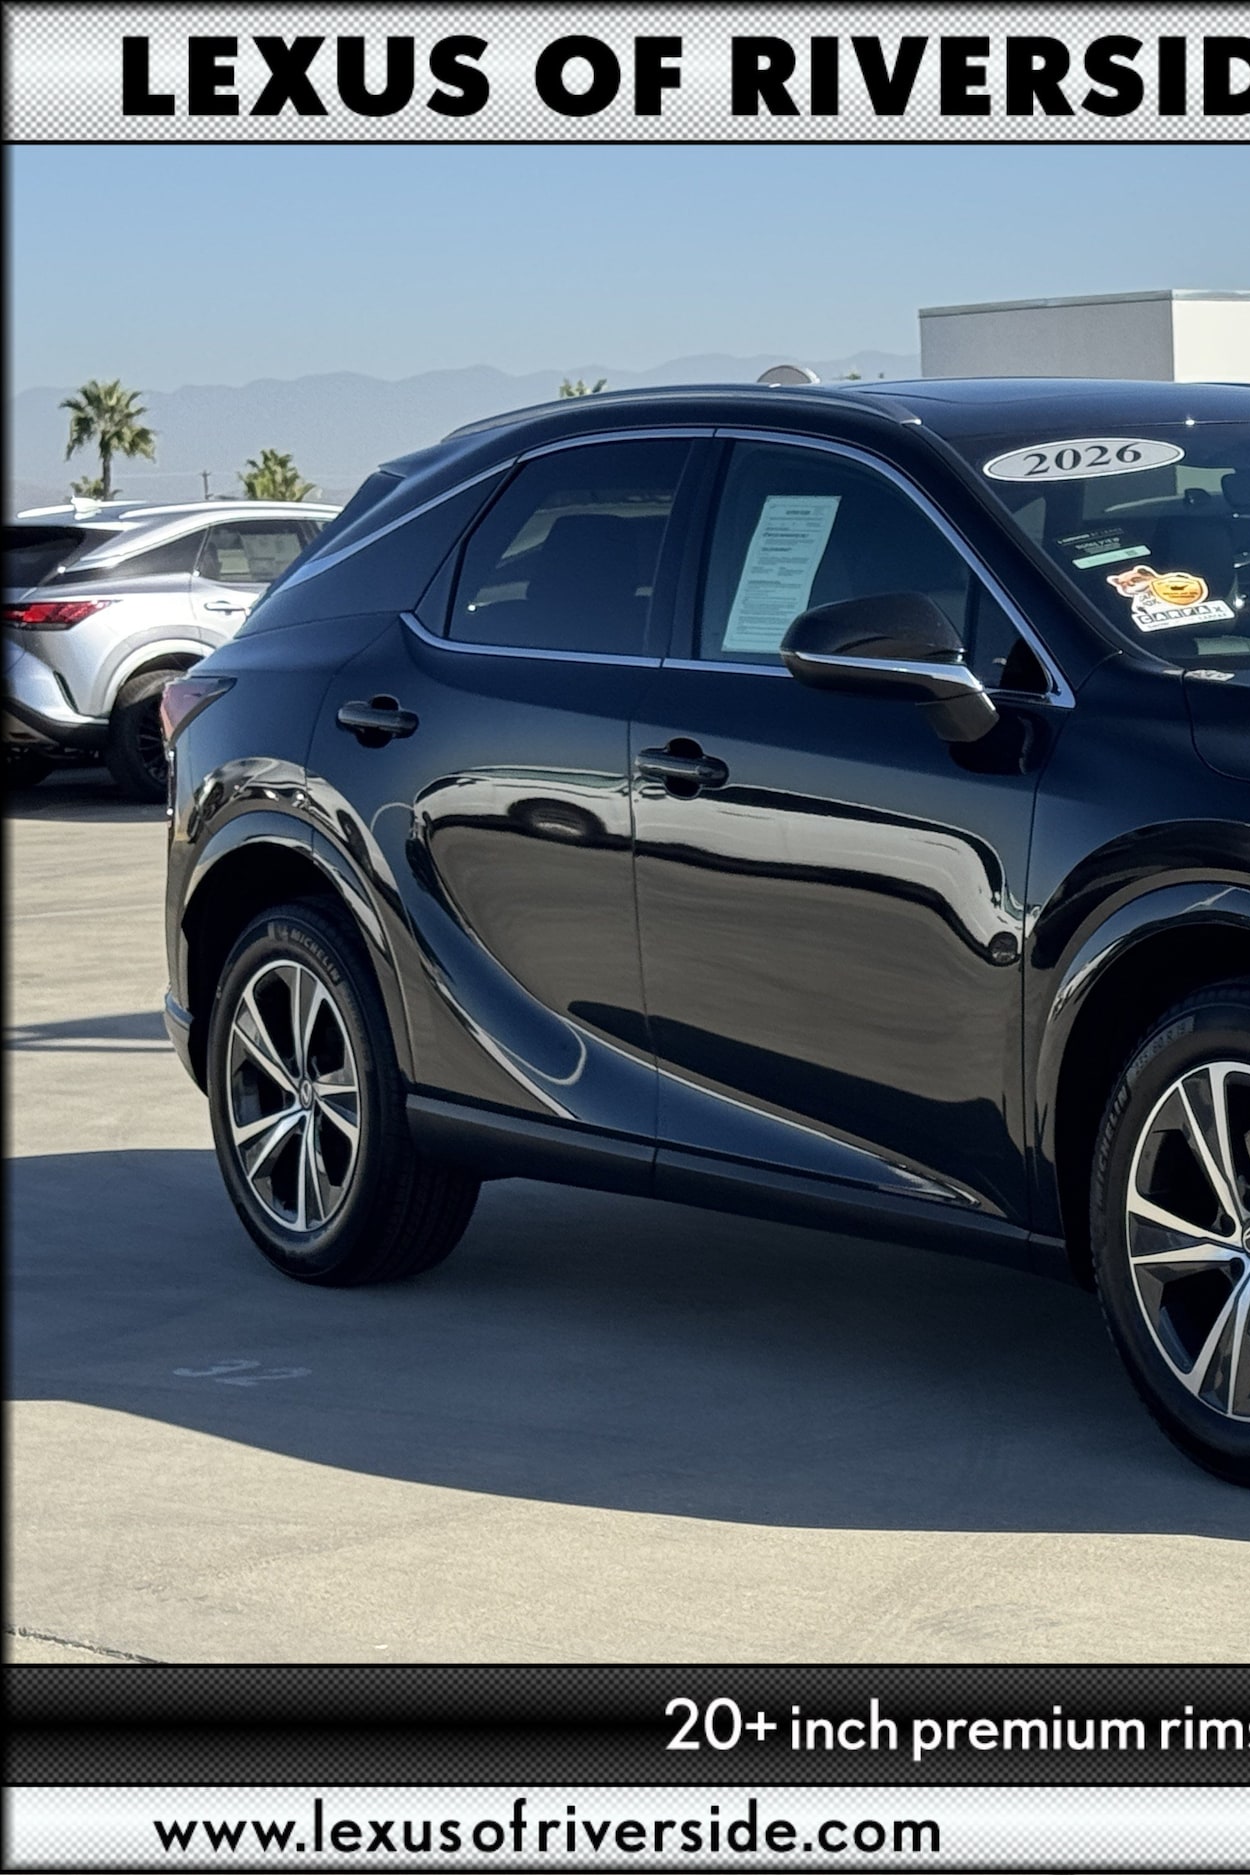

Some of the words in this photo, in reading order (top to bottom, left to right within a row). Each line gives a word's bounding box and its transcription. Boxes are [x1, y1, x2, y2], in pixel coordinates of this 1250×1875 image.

[1022, 441, 1143, 477] 2026
[1137, 604, 1224, 625] CARFAX
[290, 927, 341, 982] MICHELIN
